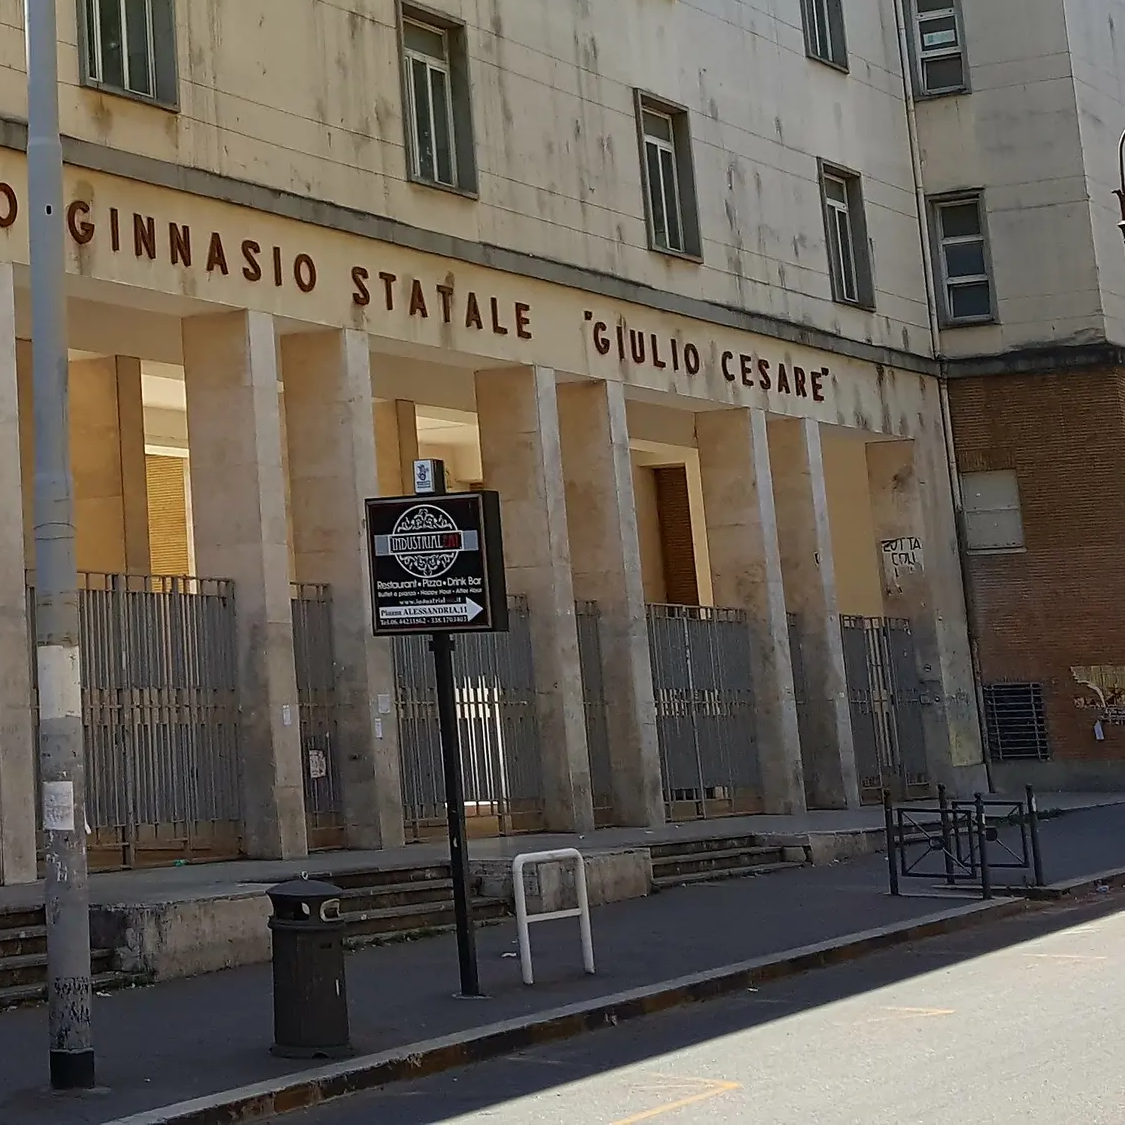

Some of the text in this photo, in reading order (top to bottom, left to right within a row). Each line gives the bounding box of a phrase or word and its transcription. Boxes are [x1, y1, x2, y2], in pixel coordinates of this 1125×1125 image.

[67, 200, 317, 293] GINNASIO
[351, 266, 532, 339] STATALE
[377, 576, 482, 589] Restaurant Pizza Drink Bar
